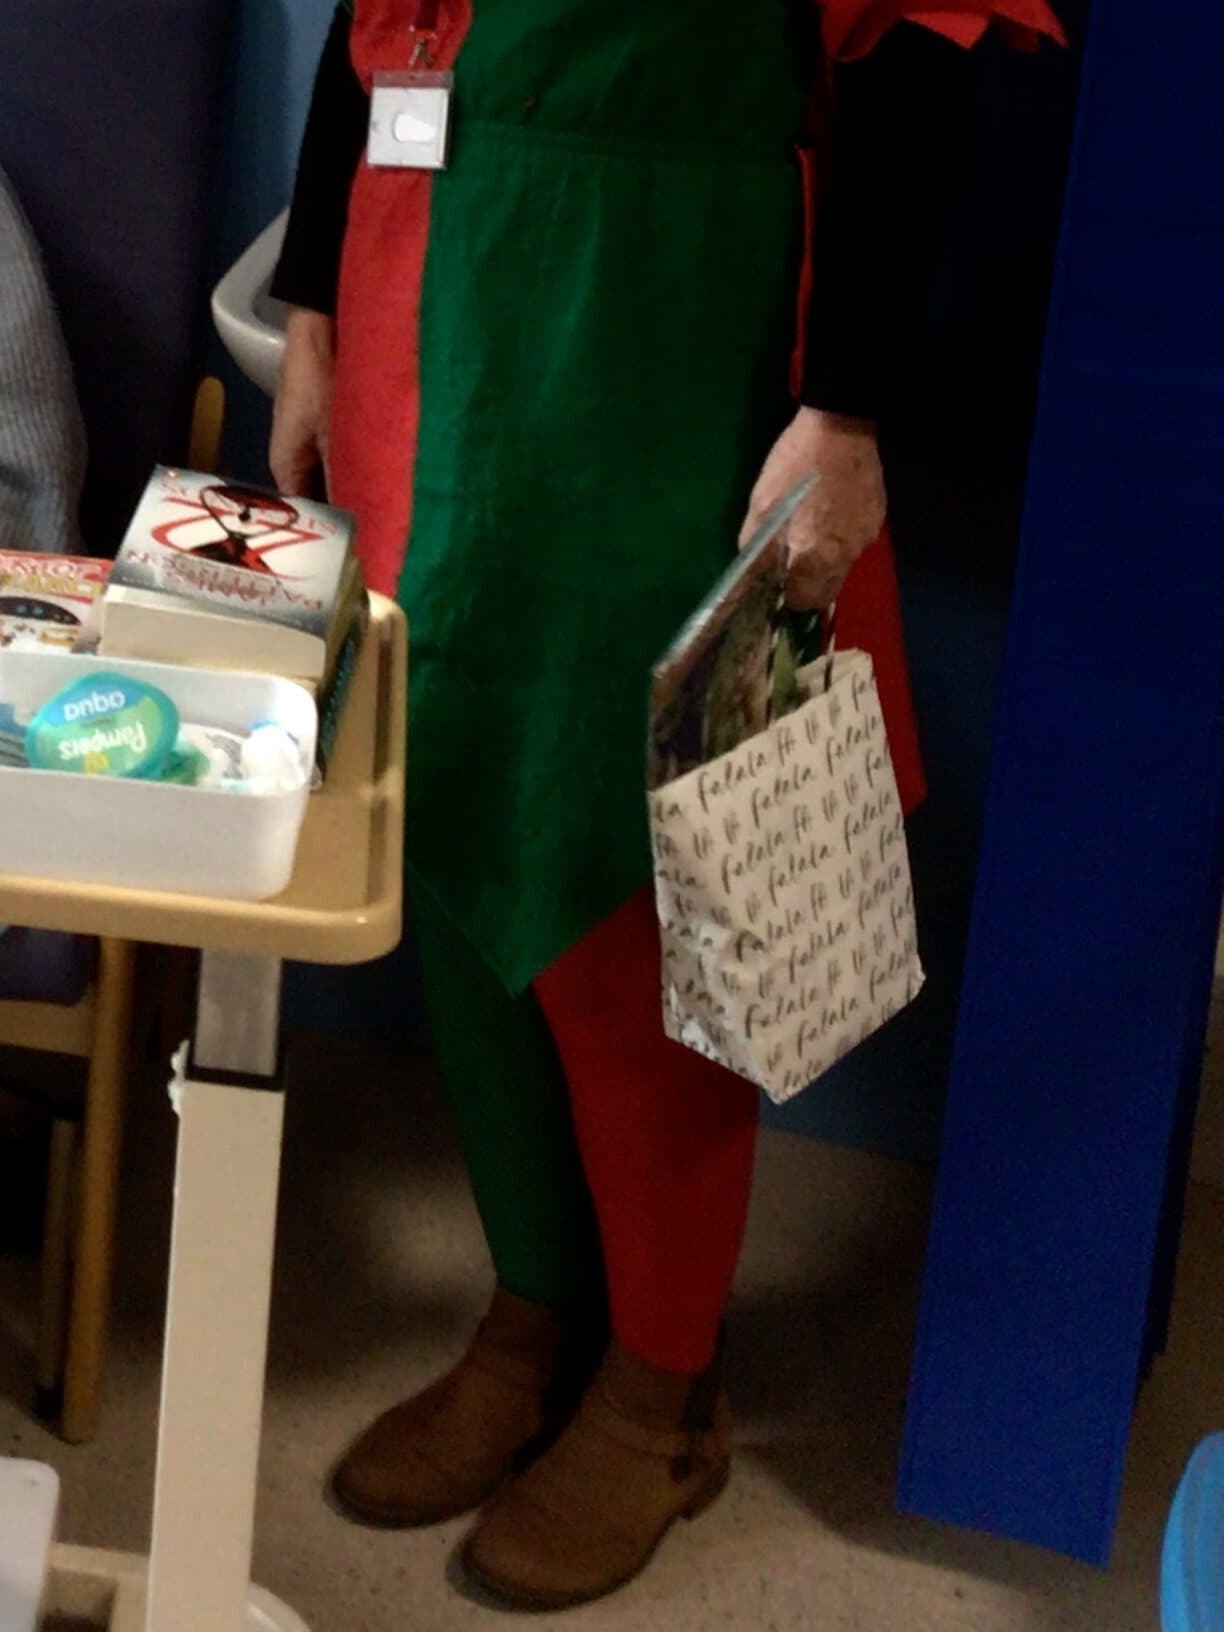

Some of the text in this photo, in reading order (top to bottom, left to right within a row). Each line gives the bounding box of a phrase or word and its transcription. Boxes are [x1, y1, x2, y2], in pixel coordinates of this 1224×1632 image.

[63, 688, 127, 722] aqua
[58, 720, 147, 761] Pampers
[698, 751, 766, 814] falala
[752, 764, 812, 829] falala
[721, 830, 784, 896] falala
[769, 844, 831, 907] falala
[789, 920, 846, 985] falala
[744, 987, 817, 1040] falala
[797, 996, 856, 1058] falala
